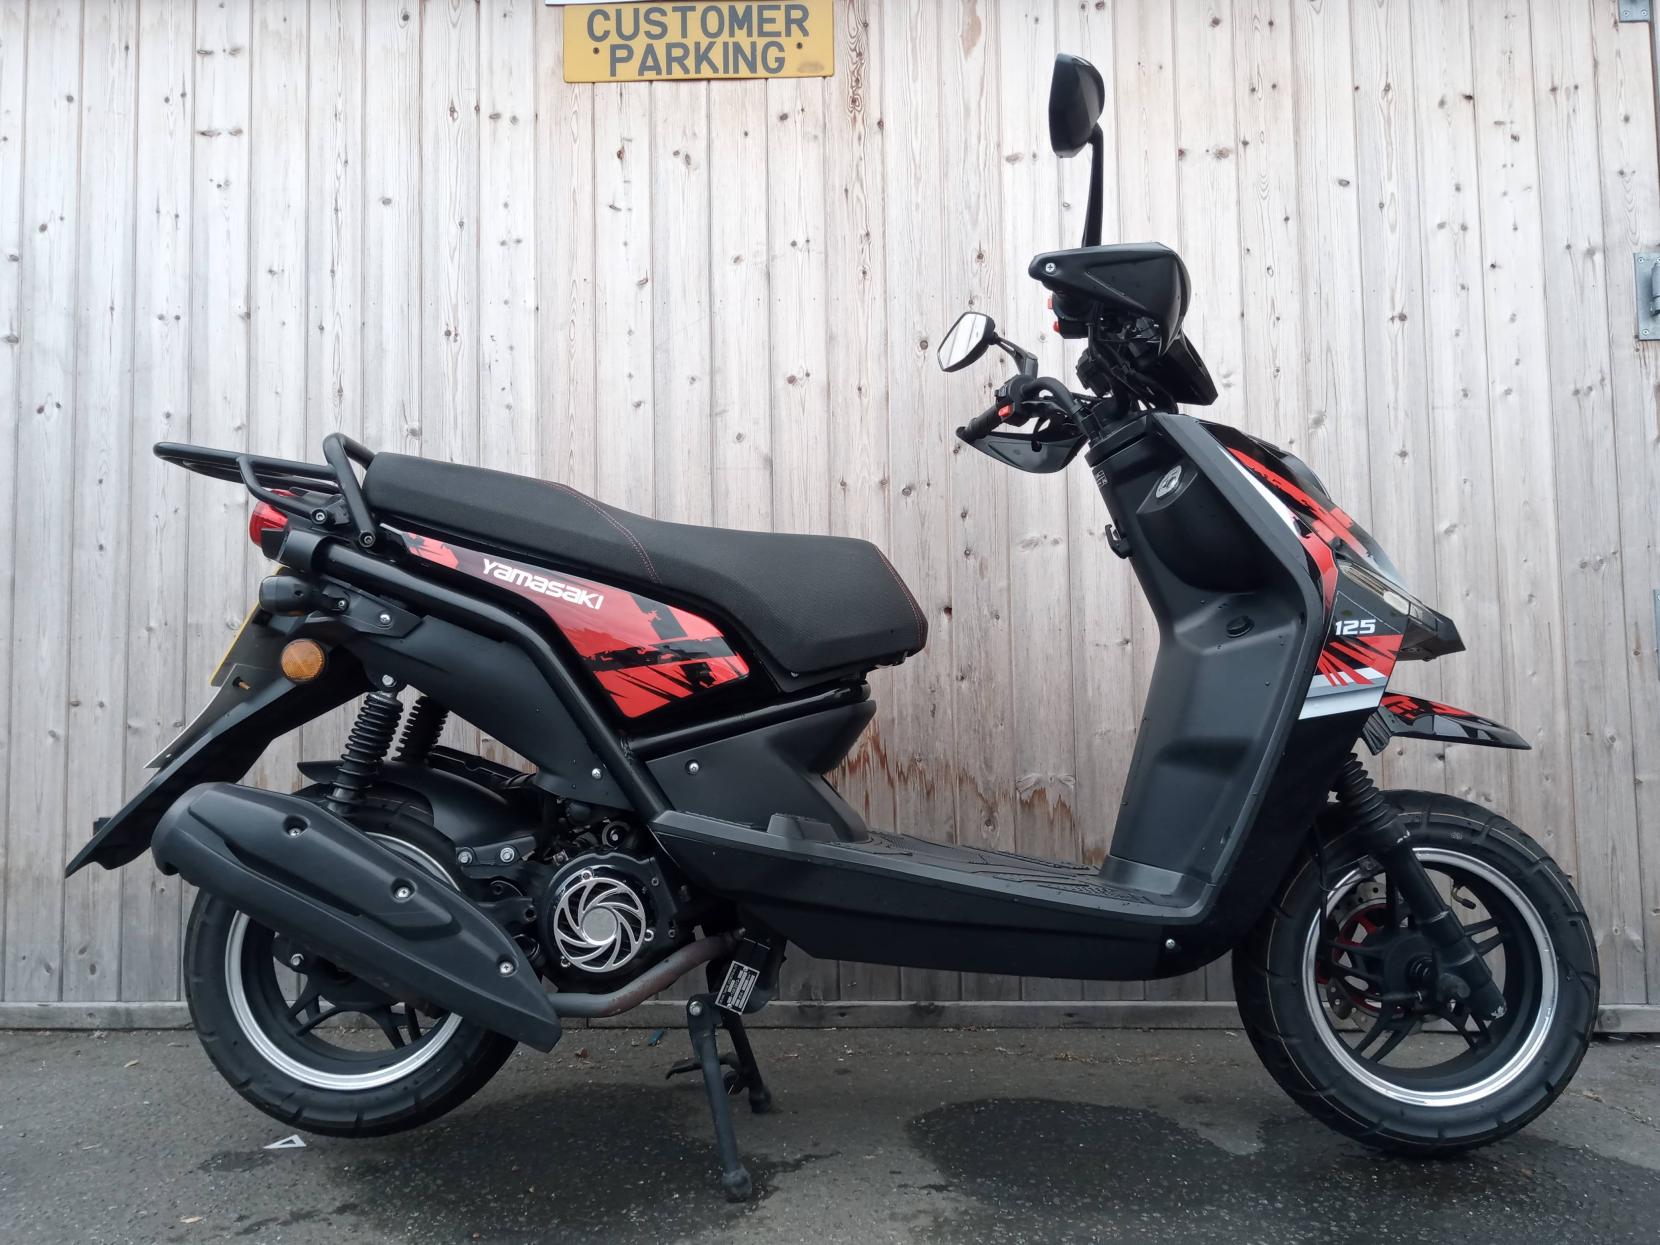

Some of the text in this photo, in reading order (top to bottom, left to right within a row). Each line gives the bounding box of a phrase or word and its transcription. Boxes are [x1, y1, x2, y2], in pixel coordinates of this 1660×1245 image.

[587, 5, 809, 42] CUSTOMER
[609, 42, 786, 76] PARKING
[1335, 619, 1376, 635] 125
